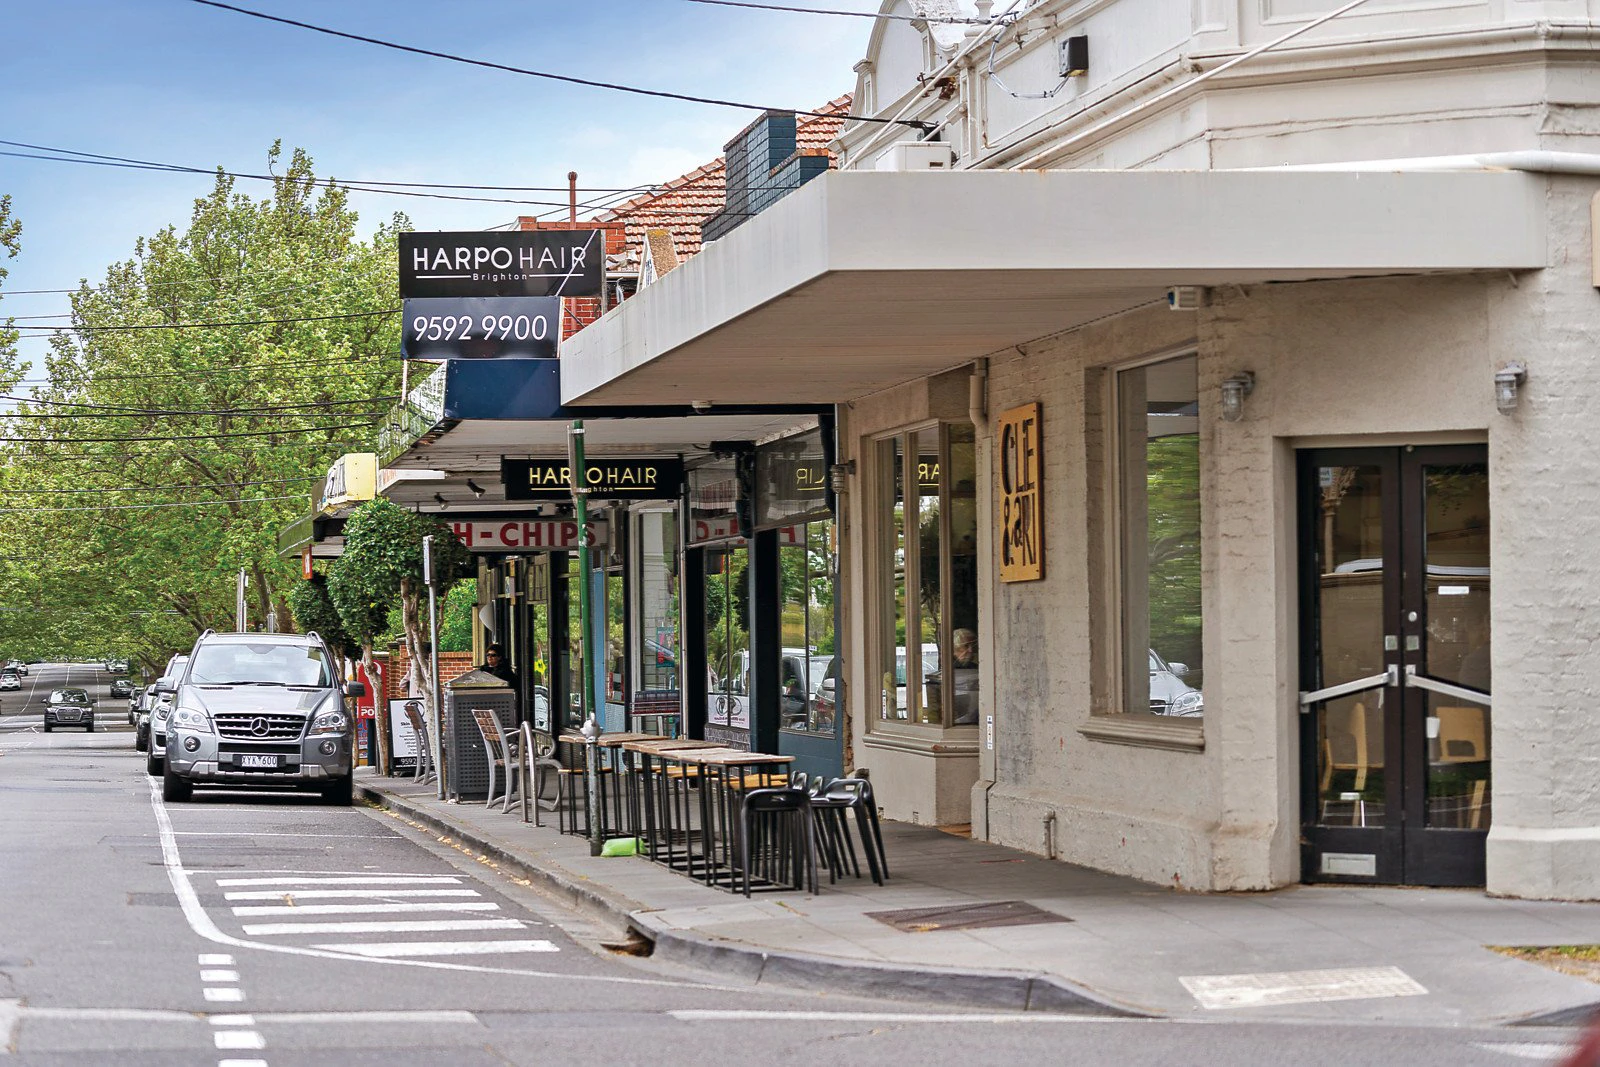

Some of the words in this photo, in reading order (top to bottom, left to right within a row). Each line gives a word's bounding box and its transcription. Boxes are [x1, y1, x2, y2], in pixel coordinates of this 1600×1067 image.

[413, 246, 513, 271] HARPO
[519, 246, 586, 269] HAIR
[472, 272, 528, 282] Brighton
[412, 315, 473, 342] 9592
[481, 315, 548, 341] 9900
[529, 466, 603, 485] HARO
[607, 467, 657, 484] HAIR
[261, 755, 278, 766] 600
